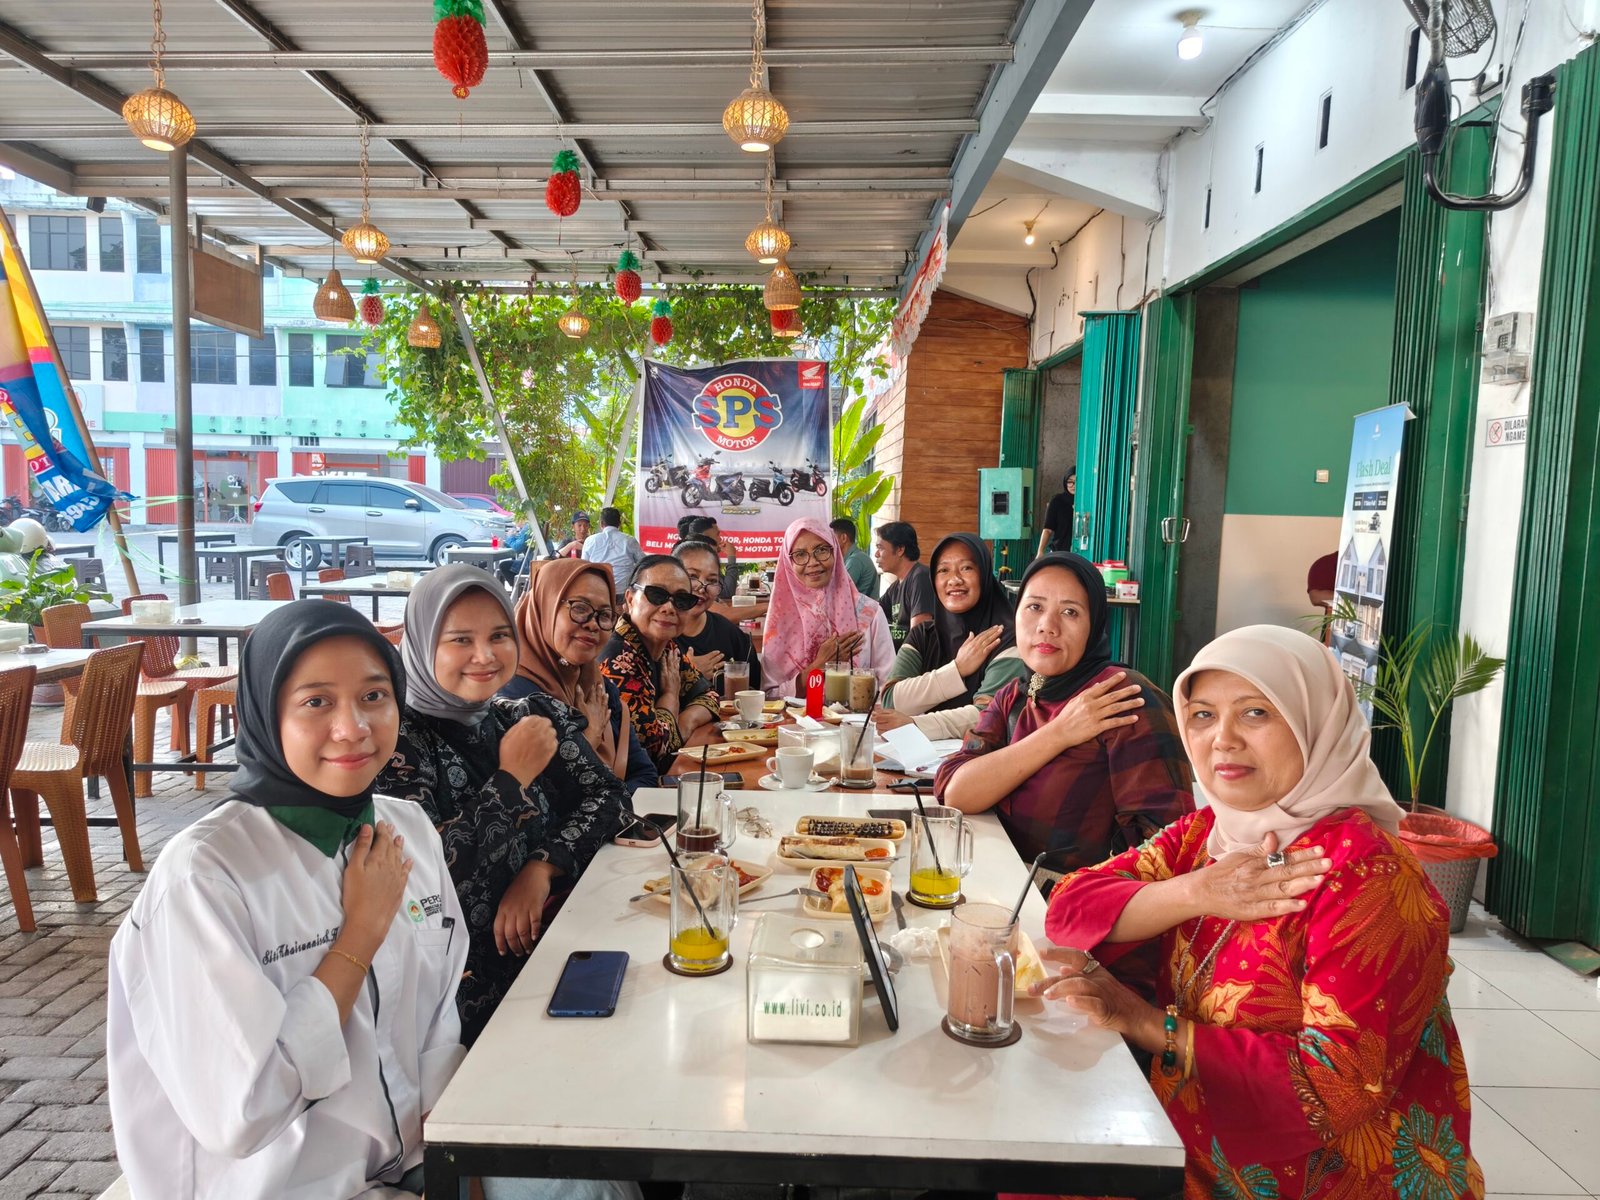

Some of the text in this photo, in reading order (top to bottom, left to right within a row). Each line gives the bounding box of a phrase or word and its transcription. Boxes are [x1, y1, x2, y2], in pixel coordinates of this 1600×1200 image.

[713, 377, 757, 393] HONDA
[693, 395, 782, 429] SPS
[1504, 418, 1528, 430] DILARAN
[716, 435, 757, 448] MOTOR
[1505, 430, 1526, 442] NGAME
[1356, 456, 1392, 478] Flash Deal
[646, 541, 663, 549] BELI
[743, 536, 771, 544] HONDA
[810, 674, 822, 689] 09
[763, 998, 843, 1018] www.livi.co.id
